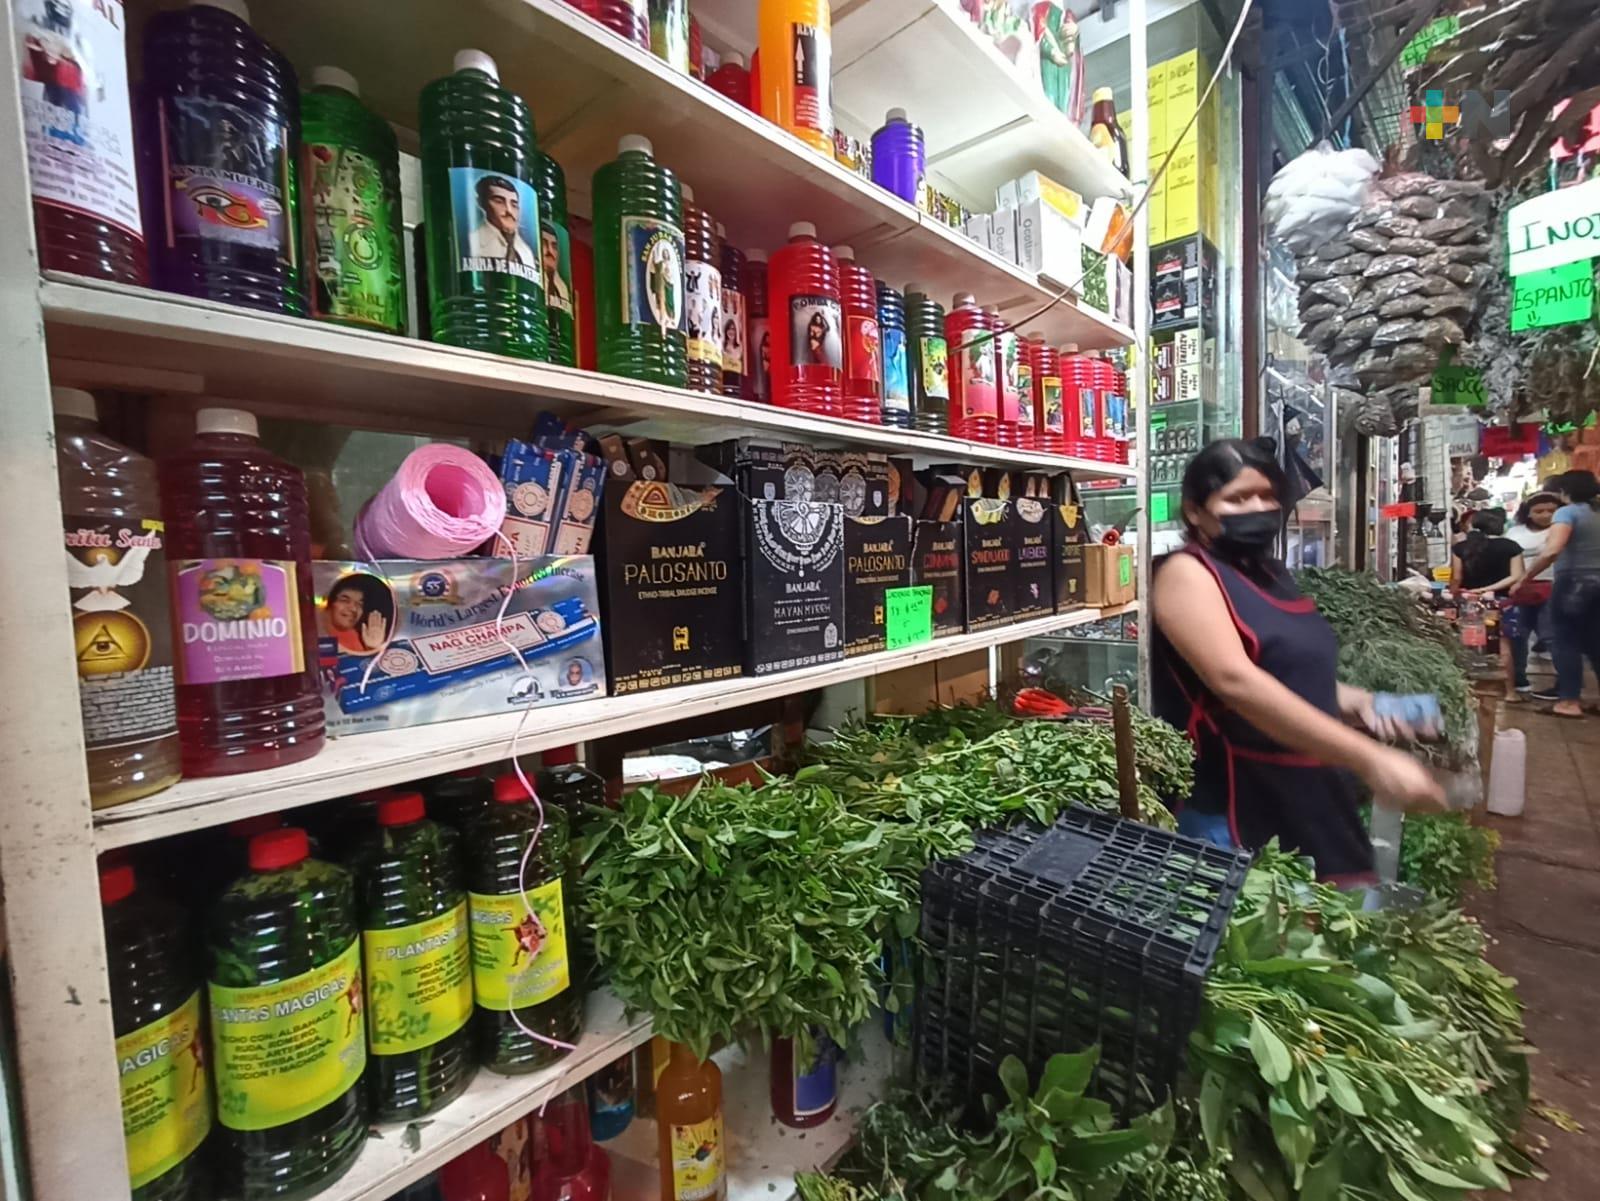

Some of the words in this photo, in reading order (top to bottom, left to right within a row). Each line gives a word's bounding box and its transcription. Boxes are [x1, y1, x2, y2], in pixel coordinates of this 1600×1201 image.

[1513, 277, 1595, 311] ESPANTO
[624, 561, 727, 585] PALOSANTO
[409, 611, 455, 629] World's
[455, 593, 501, 622] Largest
[183, 617, 287, 644] DOMINIO
[429, 635, 463, 652] NAG
[465, 622, 526, 643] CHAMPA
[387, 931, 449, 960] PLANTAS
[276, 977, 347, 1016] MAGICAS
[121, 1022, 189, 1076] AGICAS
